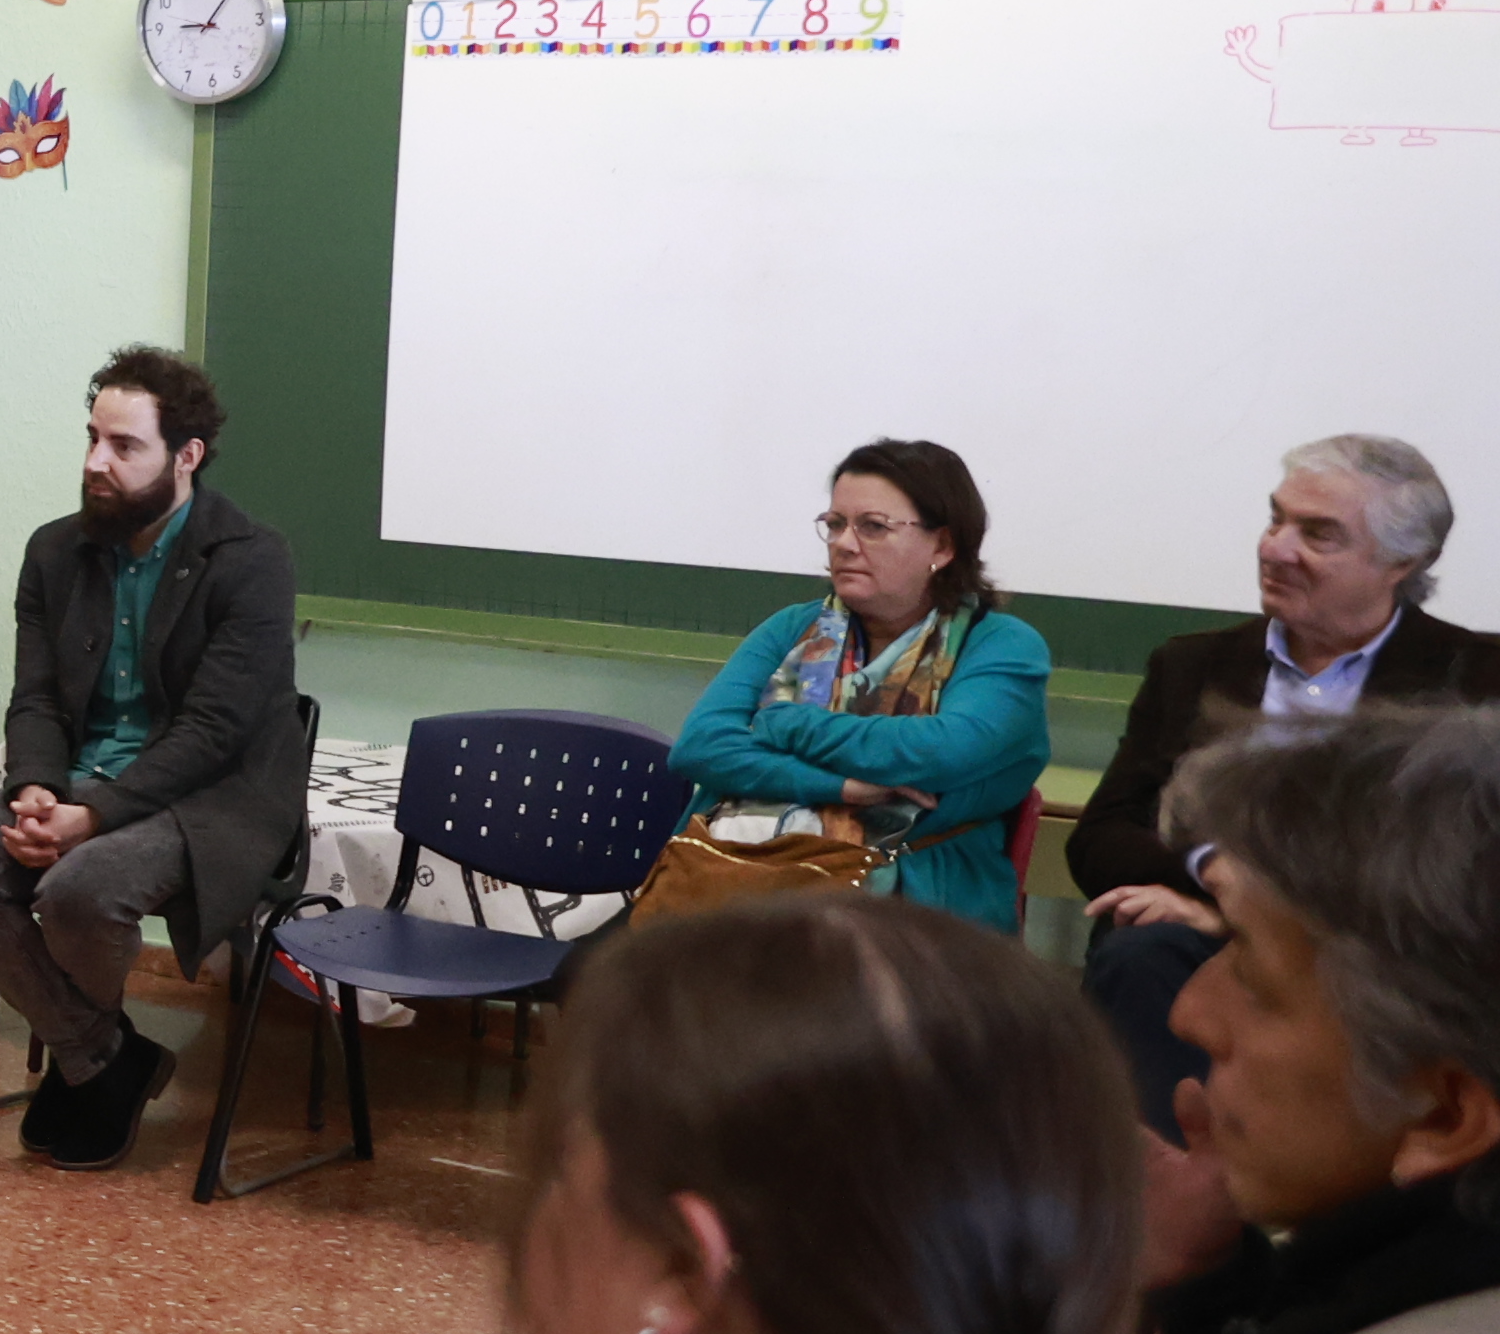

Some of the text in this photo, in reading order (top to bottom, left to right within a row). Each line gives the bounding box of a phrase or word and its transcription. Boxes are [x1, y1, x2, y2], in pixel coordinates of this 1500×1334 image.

[255, 12, 264, 26] 3
[420, 1, 444, 41] 0
[459, 1, 476, 40] 1
[494, 0, 518, 39] 2
[581, 0, 607, 38] 4
[155, 22, 163, 36] 9
[185, 70, 191, 83] 7
[233, 65, 241, 79] 5
[208, 73, 217, 88] 6
